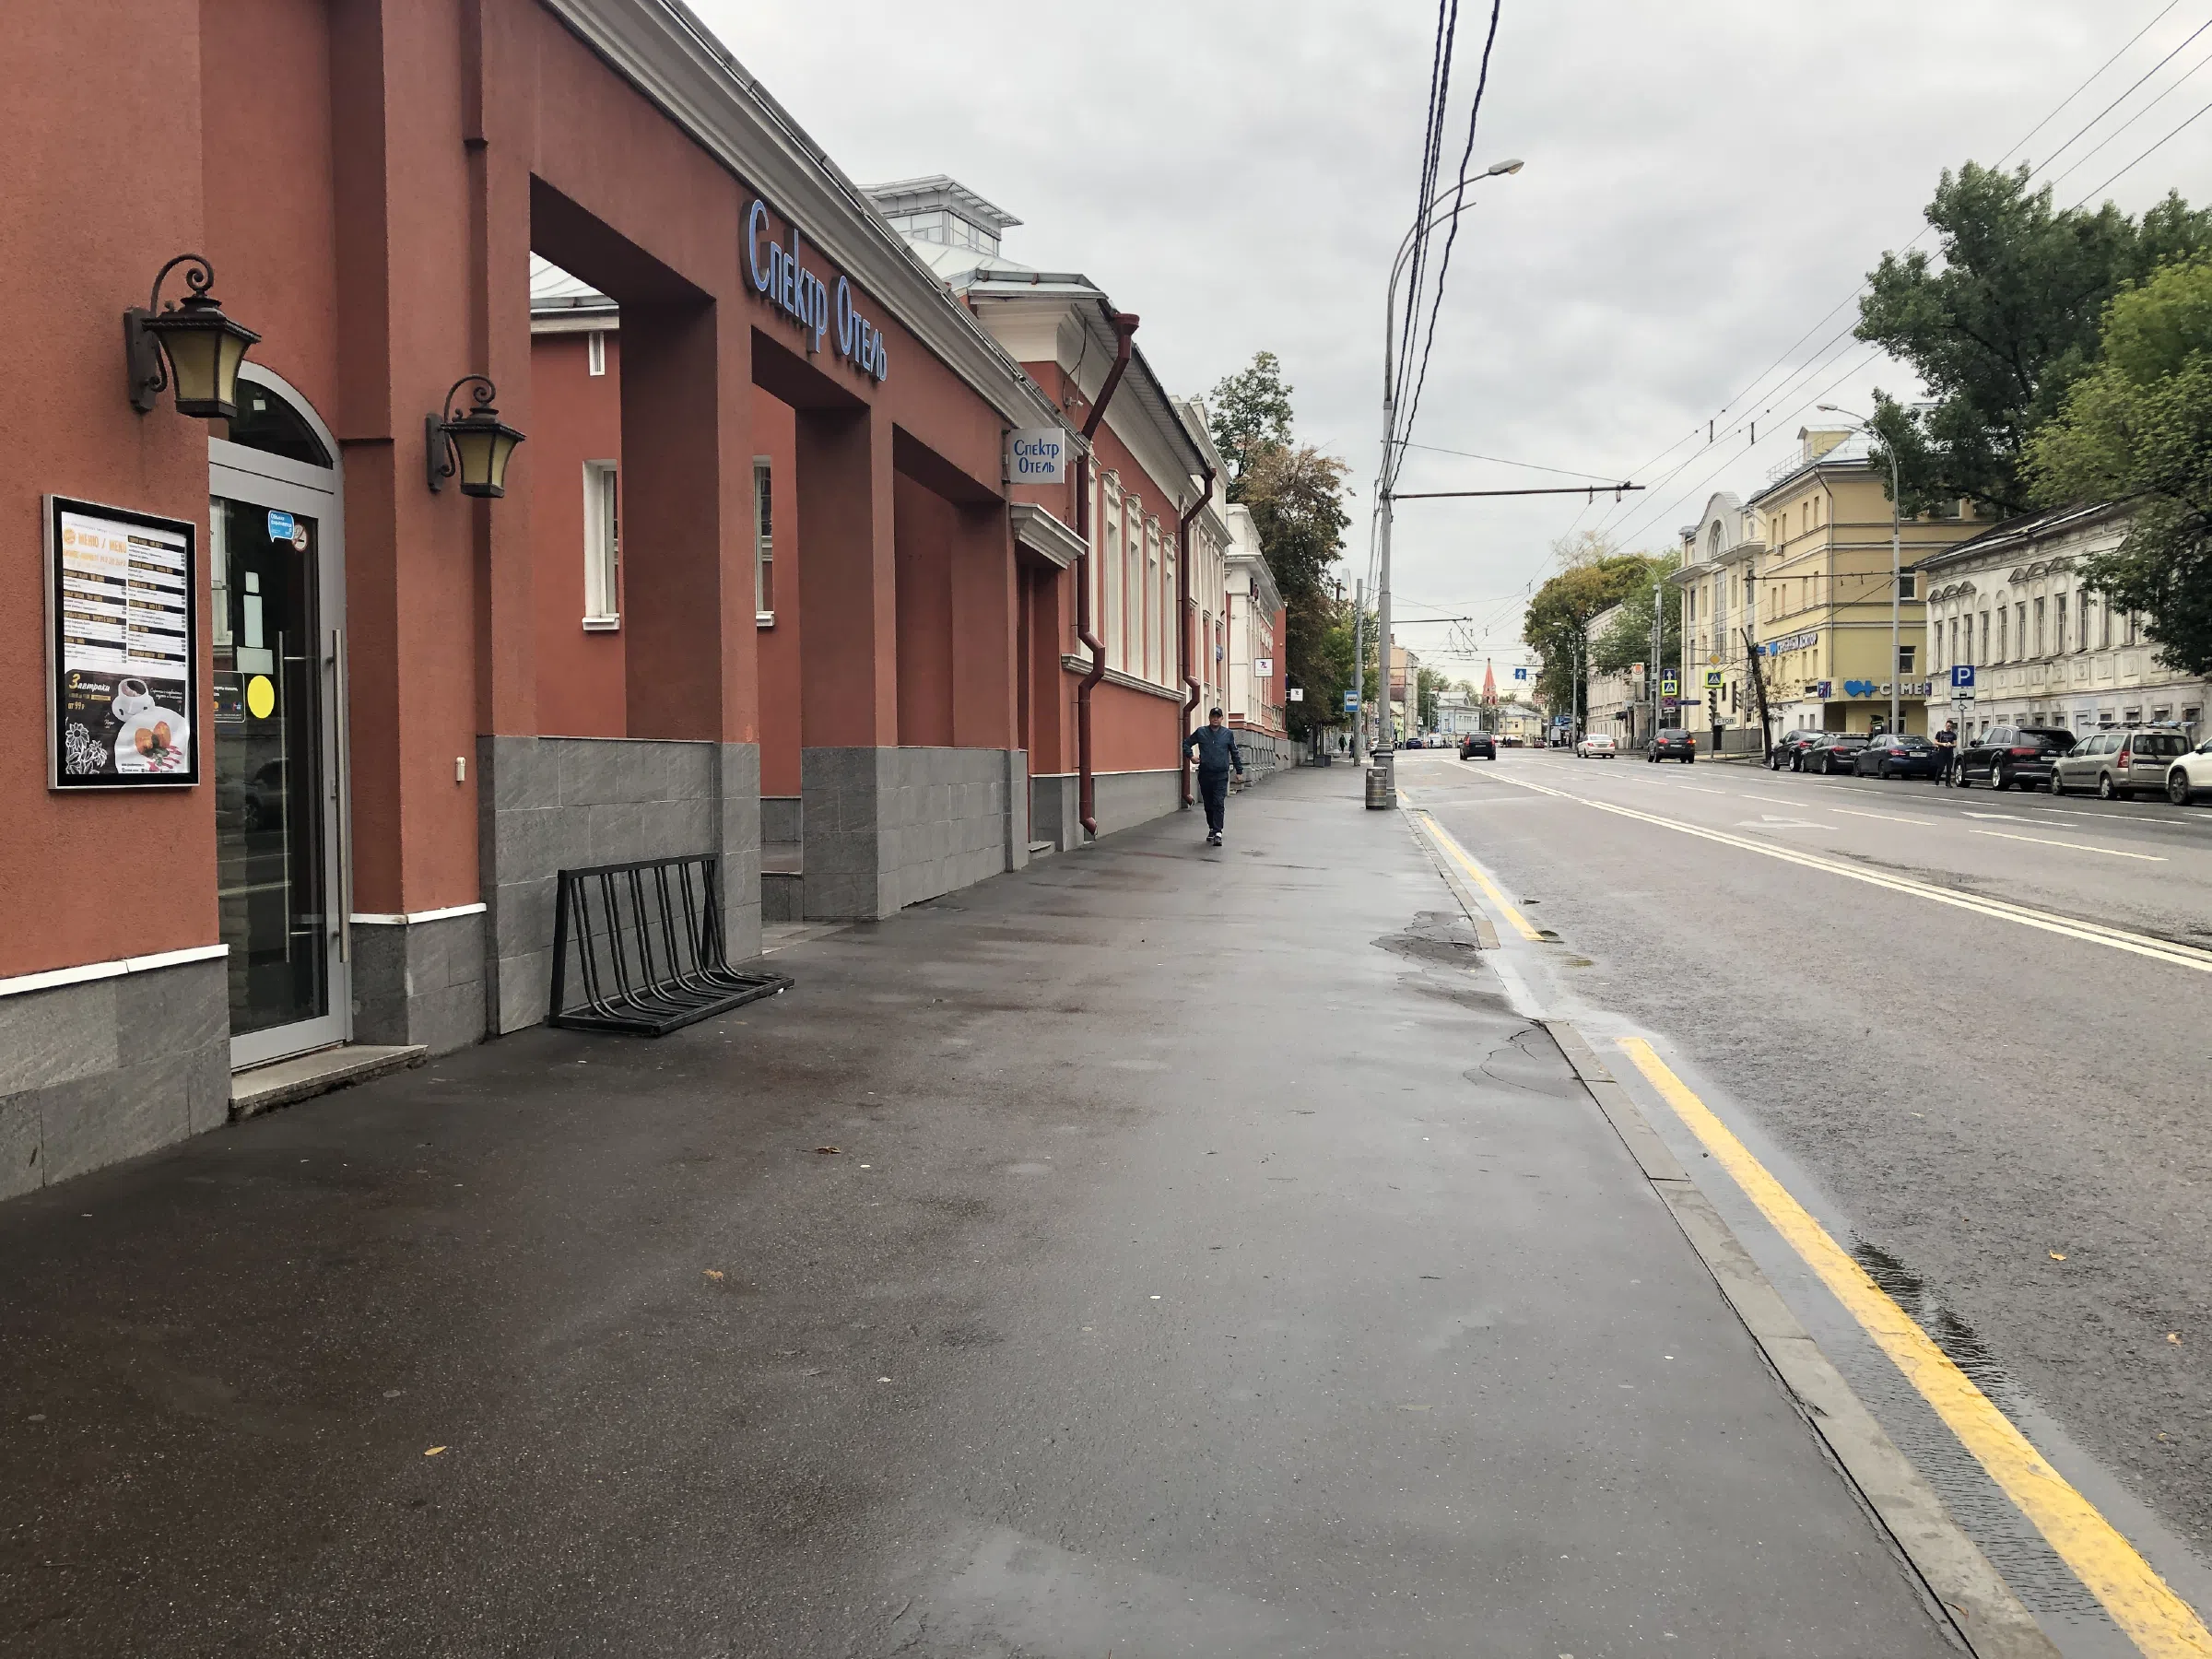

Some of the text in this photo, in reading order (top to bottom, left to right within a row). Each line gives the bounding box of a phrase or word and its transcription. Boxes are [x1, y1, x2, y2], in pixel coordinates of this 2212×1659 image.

[749, 199, 888, 382] Спектр Отель
[1014, 439, 1060, 459] Спектр
[1018, 457, 1055, 473] Отель
[1958, 667, 1971, 685] P
[1880, 683, 1926, 696] СМЕ
